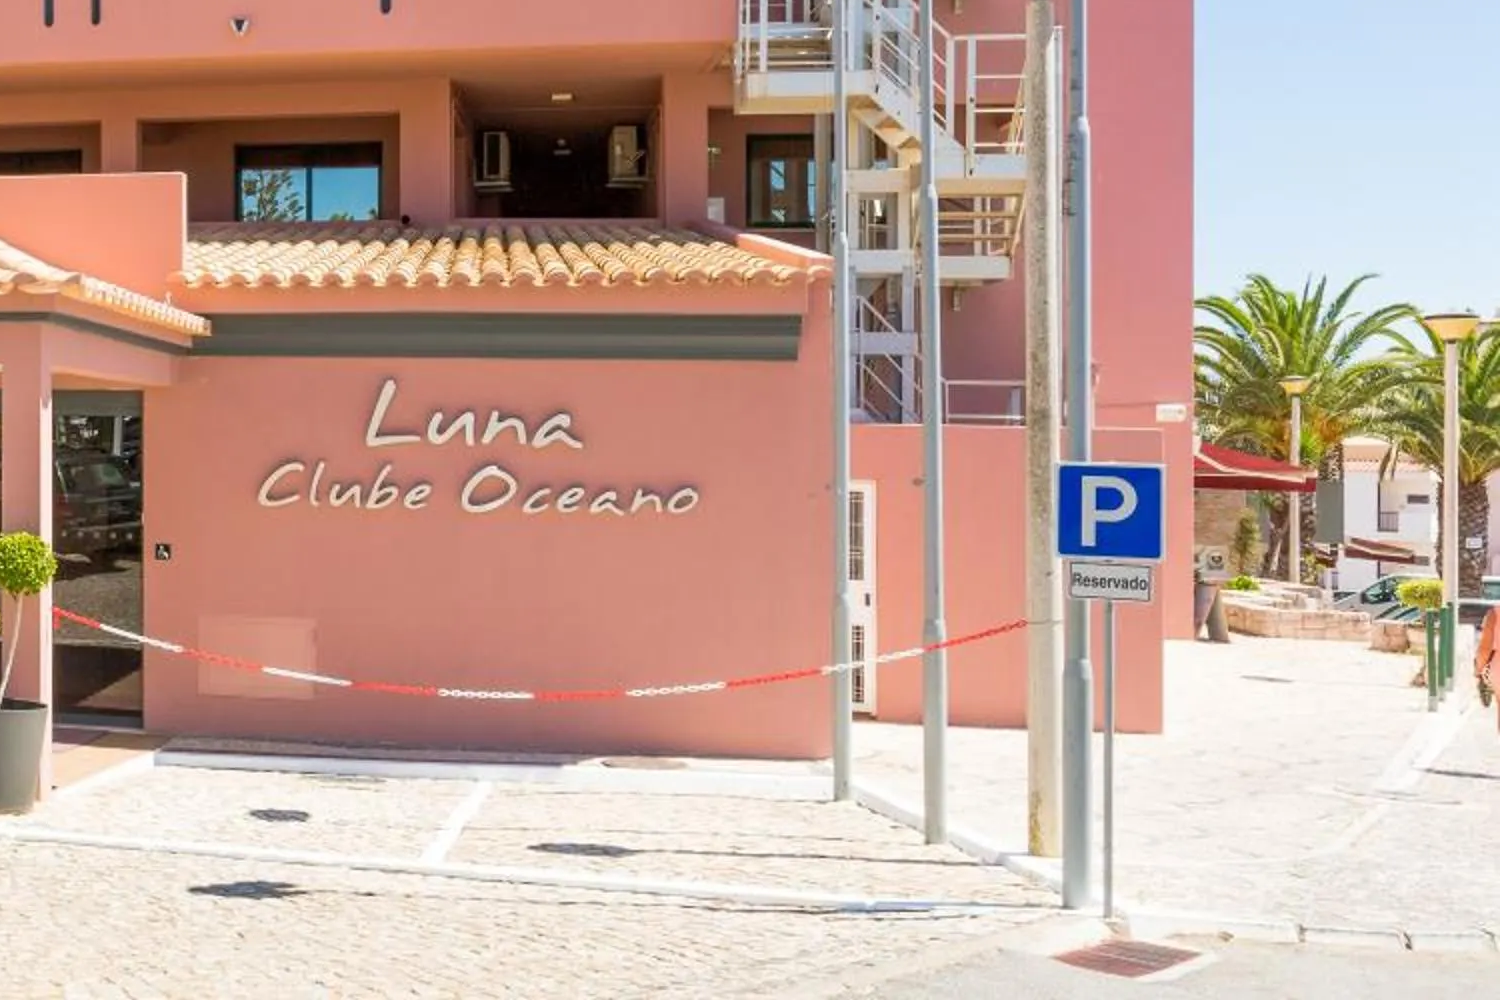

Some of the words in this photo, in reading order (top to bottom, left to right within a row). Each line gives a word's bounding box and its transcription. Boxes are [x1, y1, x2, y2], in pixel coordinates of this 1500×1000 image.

[365, 379, 583, 450] Luna
[257, 461, 433, 511] Clube
[460, 465, 700, 516] Oceano
[1081, 475, 1138, 547] P
[1073, 572, 1148, 590] Reservado
